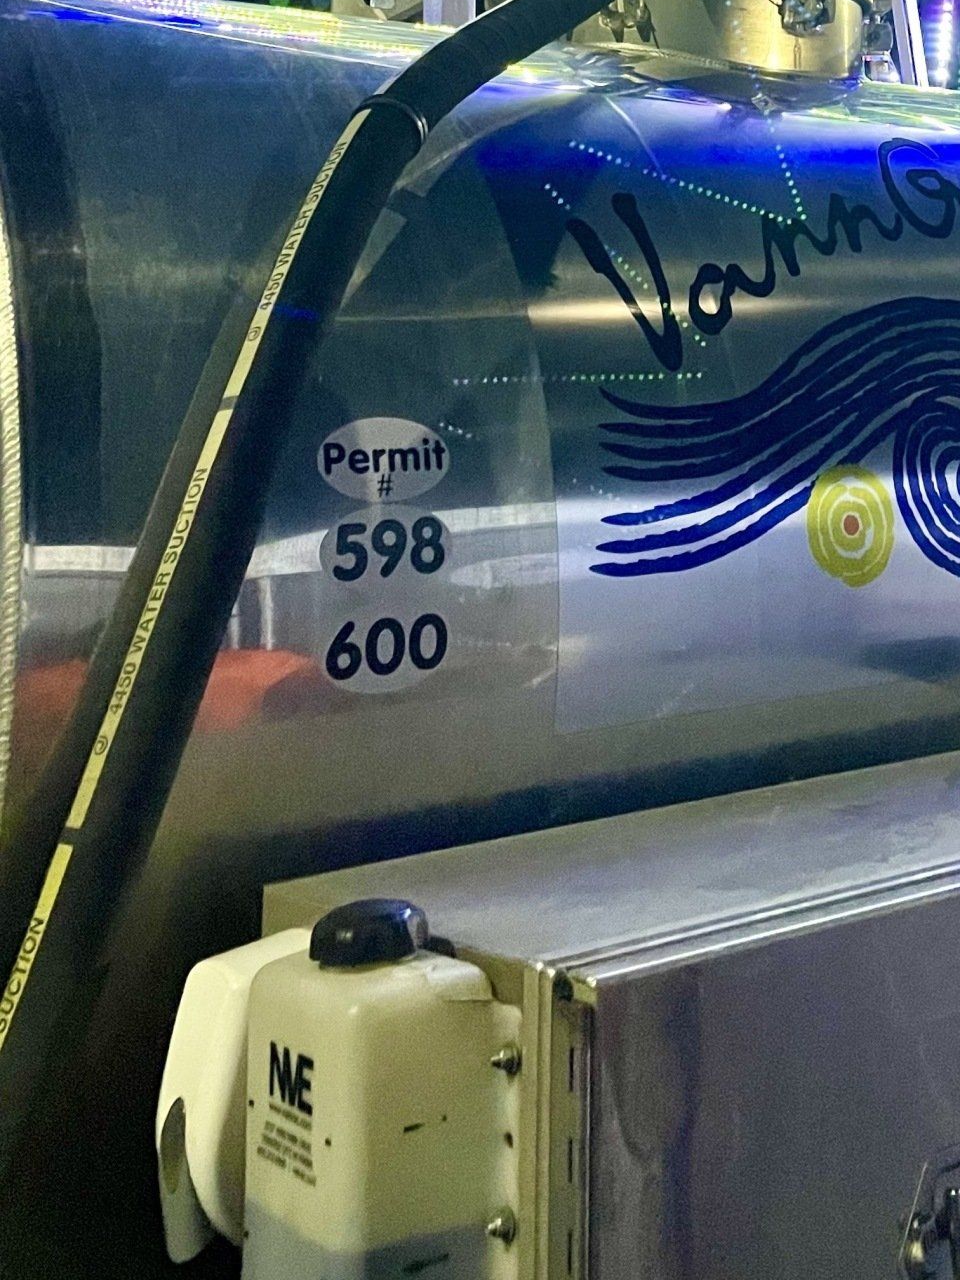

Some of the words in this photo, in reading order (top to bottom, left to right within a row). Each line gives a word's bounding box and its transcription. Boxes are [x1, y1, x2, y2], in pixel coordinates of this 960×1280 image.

[259, 273, 284, 311] 4450
[276, 208, 313, 269] WATER
[305, 141, 348, 203] SUCTION
[322, 438, 446, 475] Permit
[377, 474, 393, 498] #
[332, 516, 445, 581] 598
[109, 662, 136, 715] 4450
[131, 572, 171, 653] WATER
[163, 468, 208, 564] SUCTION
[325, 613, 447, 681] 600
